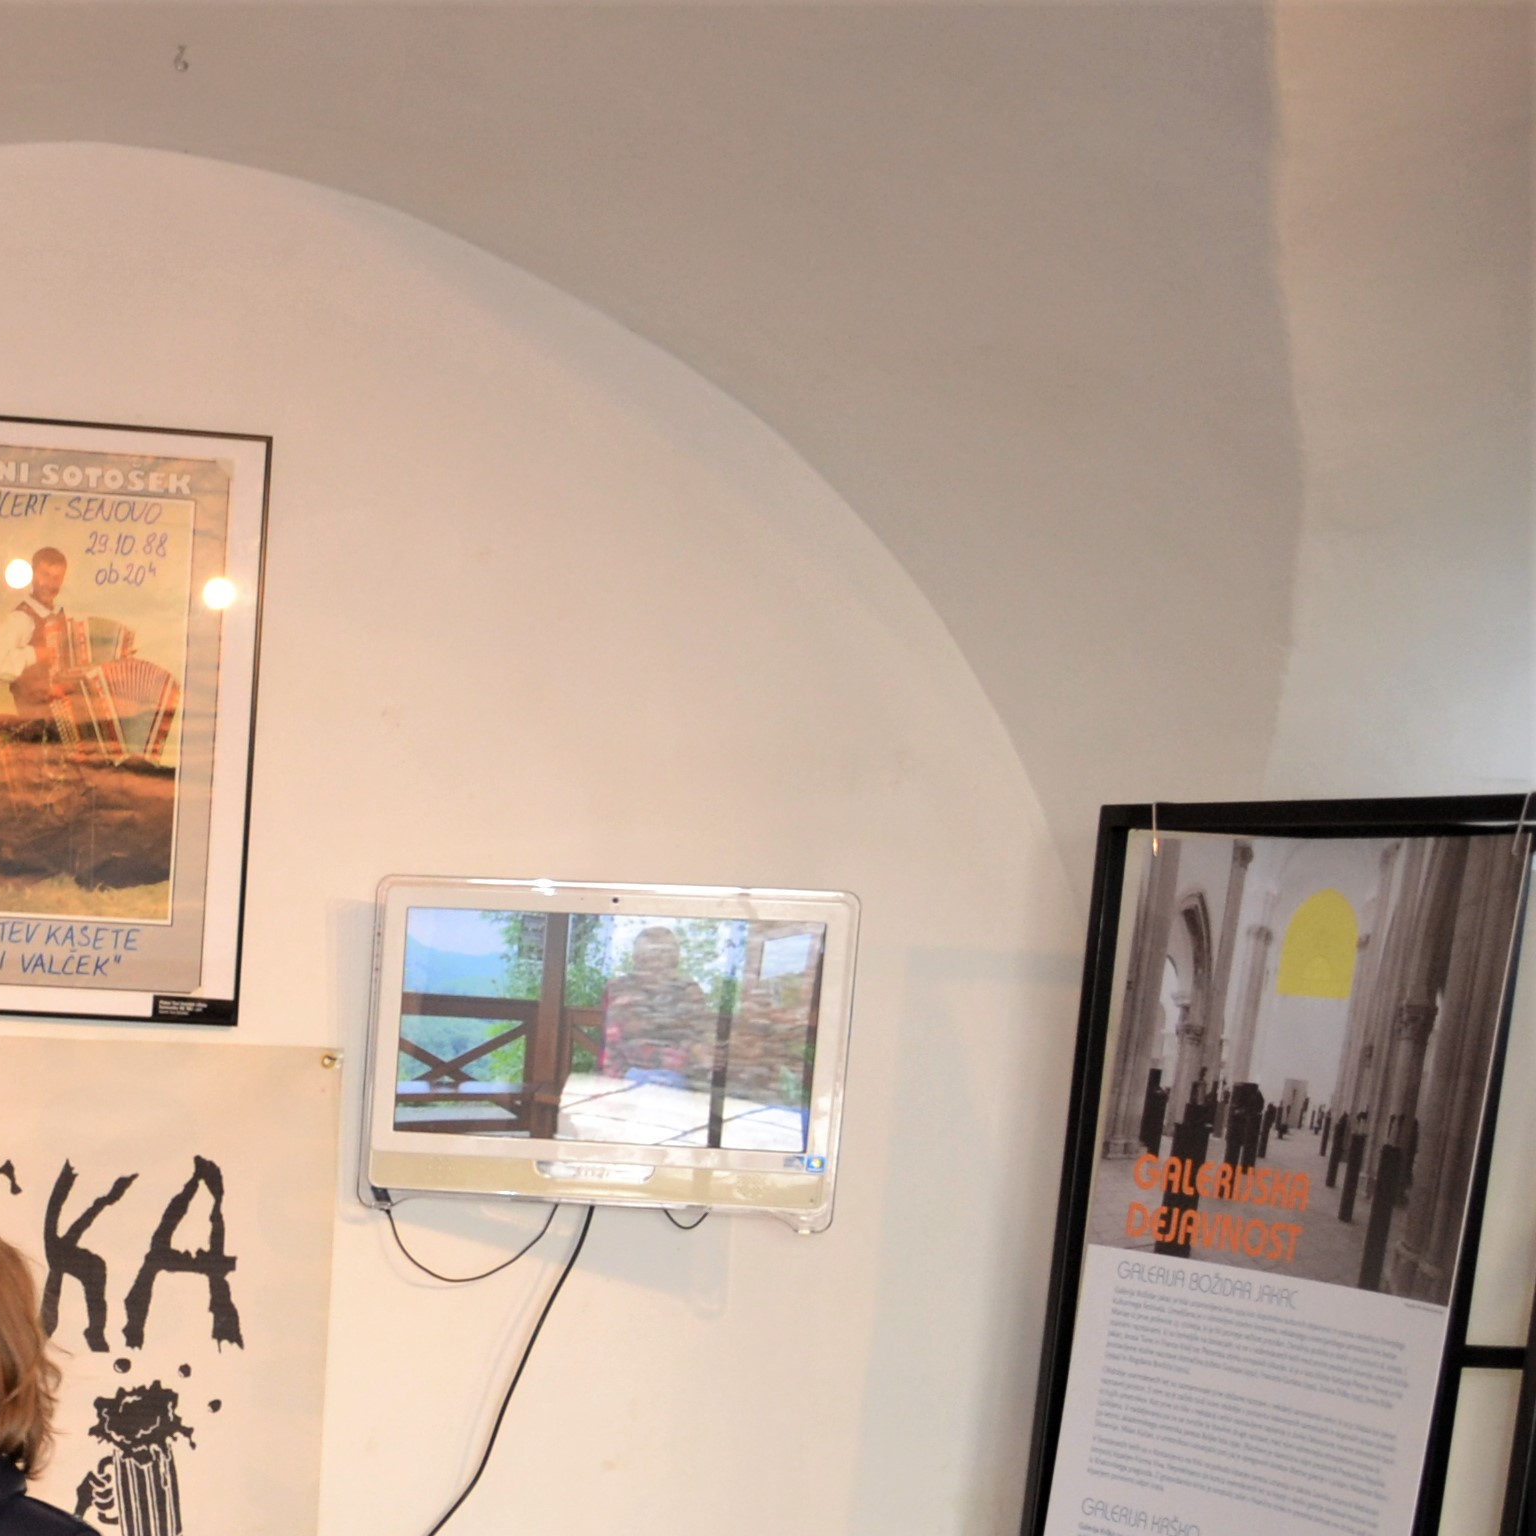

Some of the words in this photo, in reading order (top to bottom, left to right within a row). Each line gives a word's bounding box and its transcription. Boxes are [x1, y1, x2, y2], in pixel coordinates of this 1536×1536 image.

[41, 461, 192, 495] SOTOŠEK
[64, 496, 163, 525] SENOVO
[95, 563, 120, 586] ob
[45, 925, 141, 951] KASETE
[1132, 1153, 1310, 1212] GALERIJSKA
[1125, 1201, 1303, 1262] DEJAVNOST
[1116, 1260, 1186, 1289] GALERIJA
[1189, 1272, 1253, 1300] BOŽIDAR
[1256, 1284, 1299, 1310] JAKAC
[1081, 1497, 1148, 1530] GALERIJA
